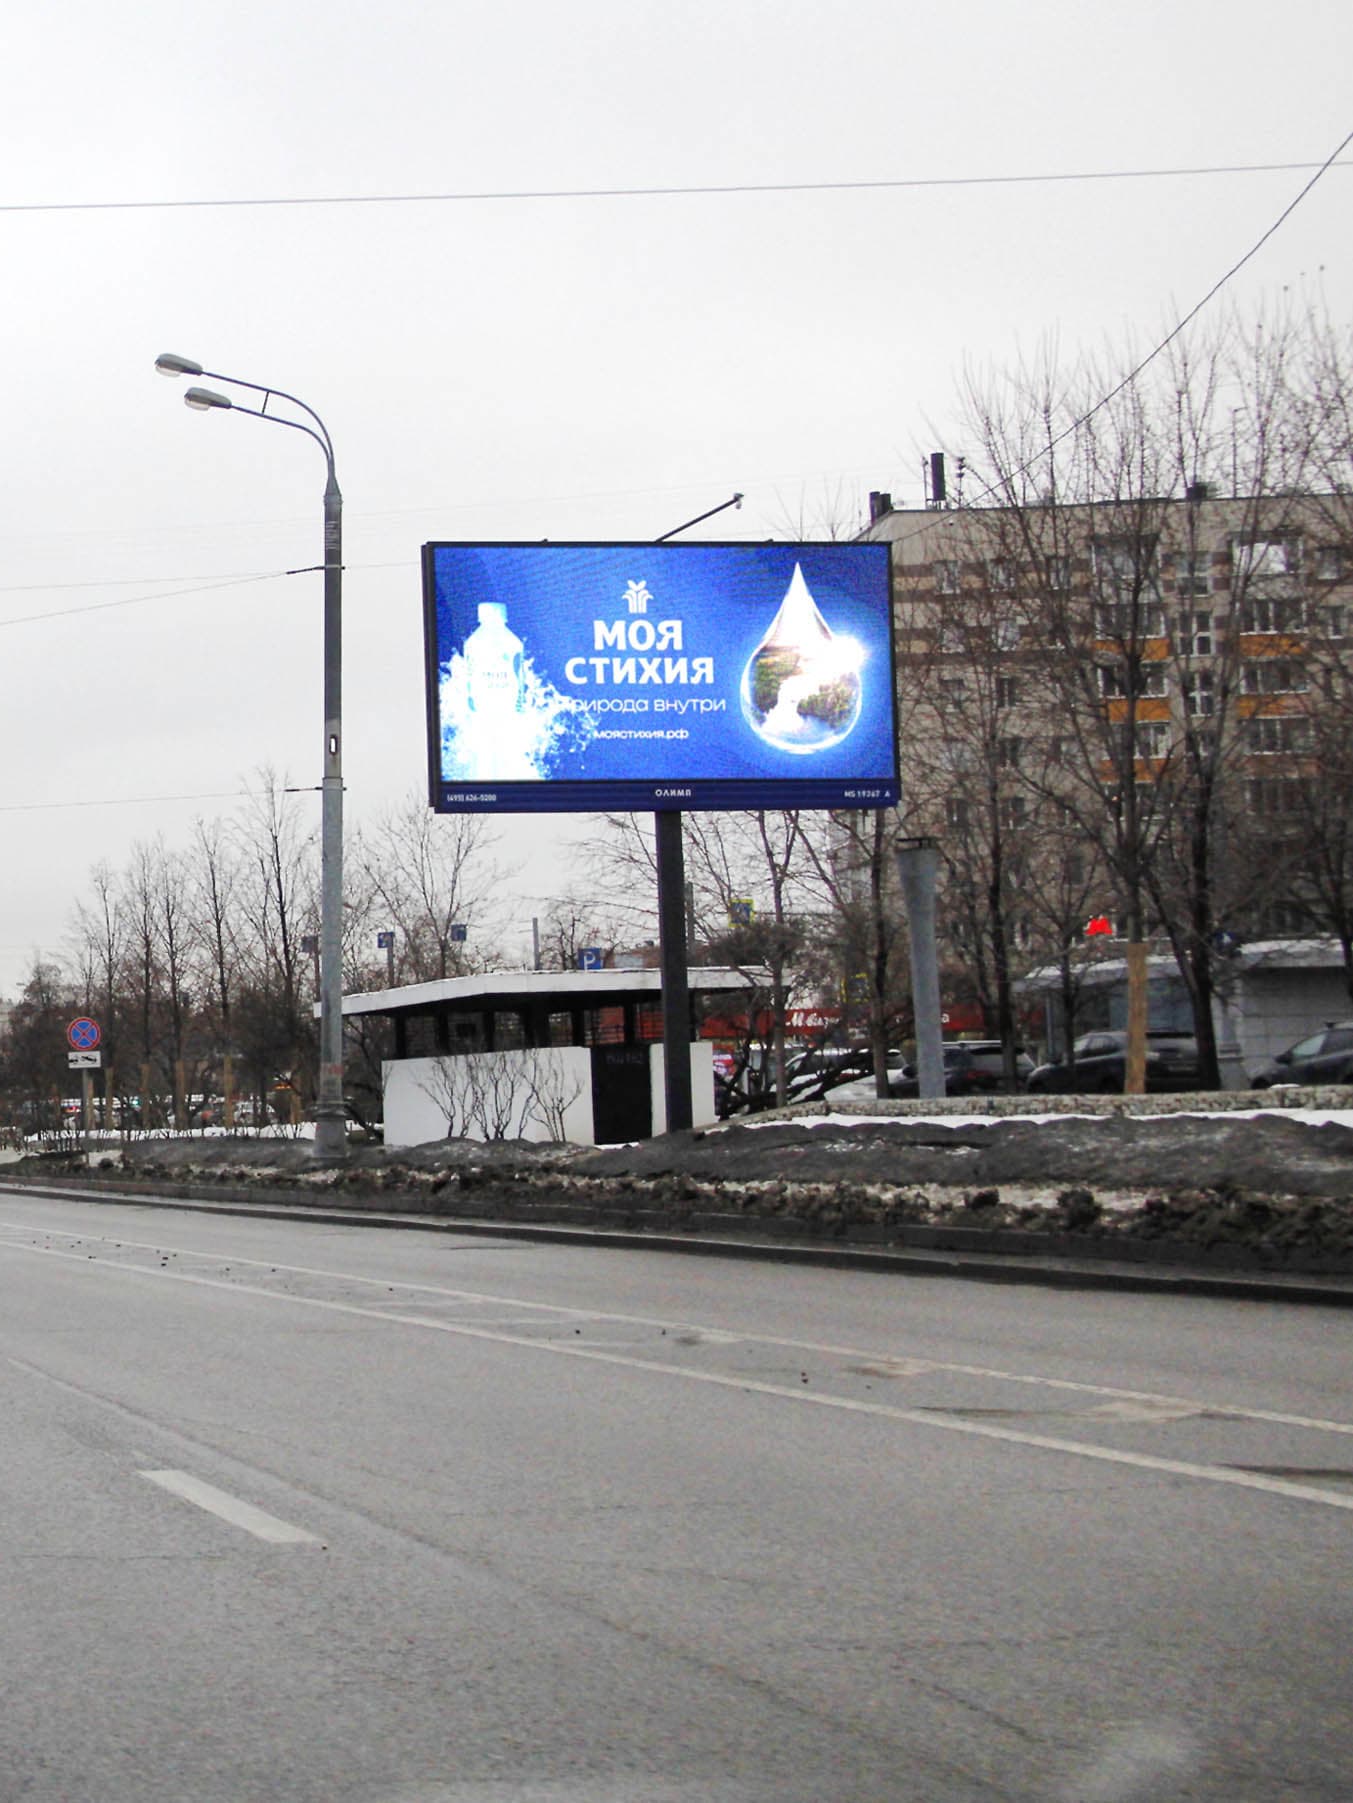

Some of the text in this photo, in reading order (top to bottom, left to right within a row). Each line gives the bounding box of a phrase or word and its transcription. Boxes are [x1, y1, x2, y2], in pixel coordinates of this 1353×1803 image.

[593, 619, 683, 651] МОЯ
[564, 657, 715, 685] СТИХИЯ
[559, 699, 726, 715] рирода внутри
[655, 788, 692, 797] ОЛИМП
